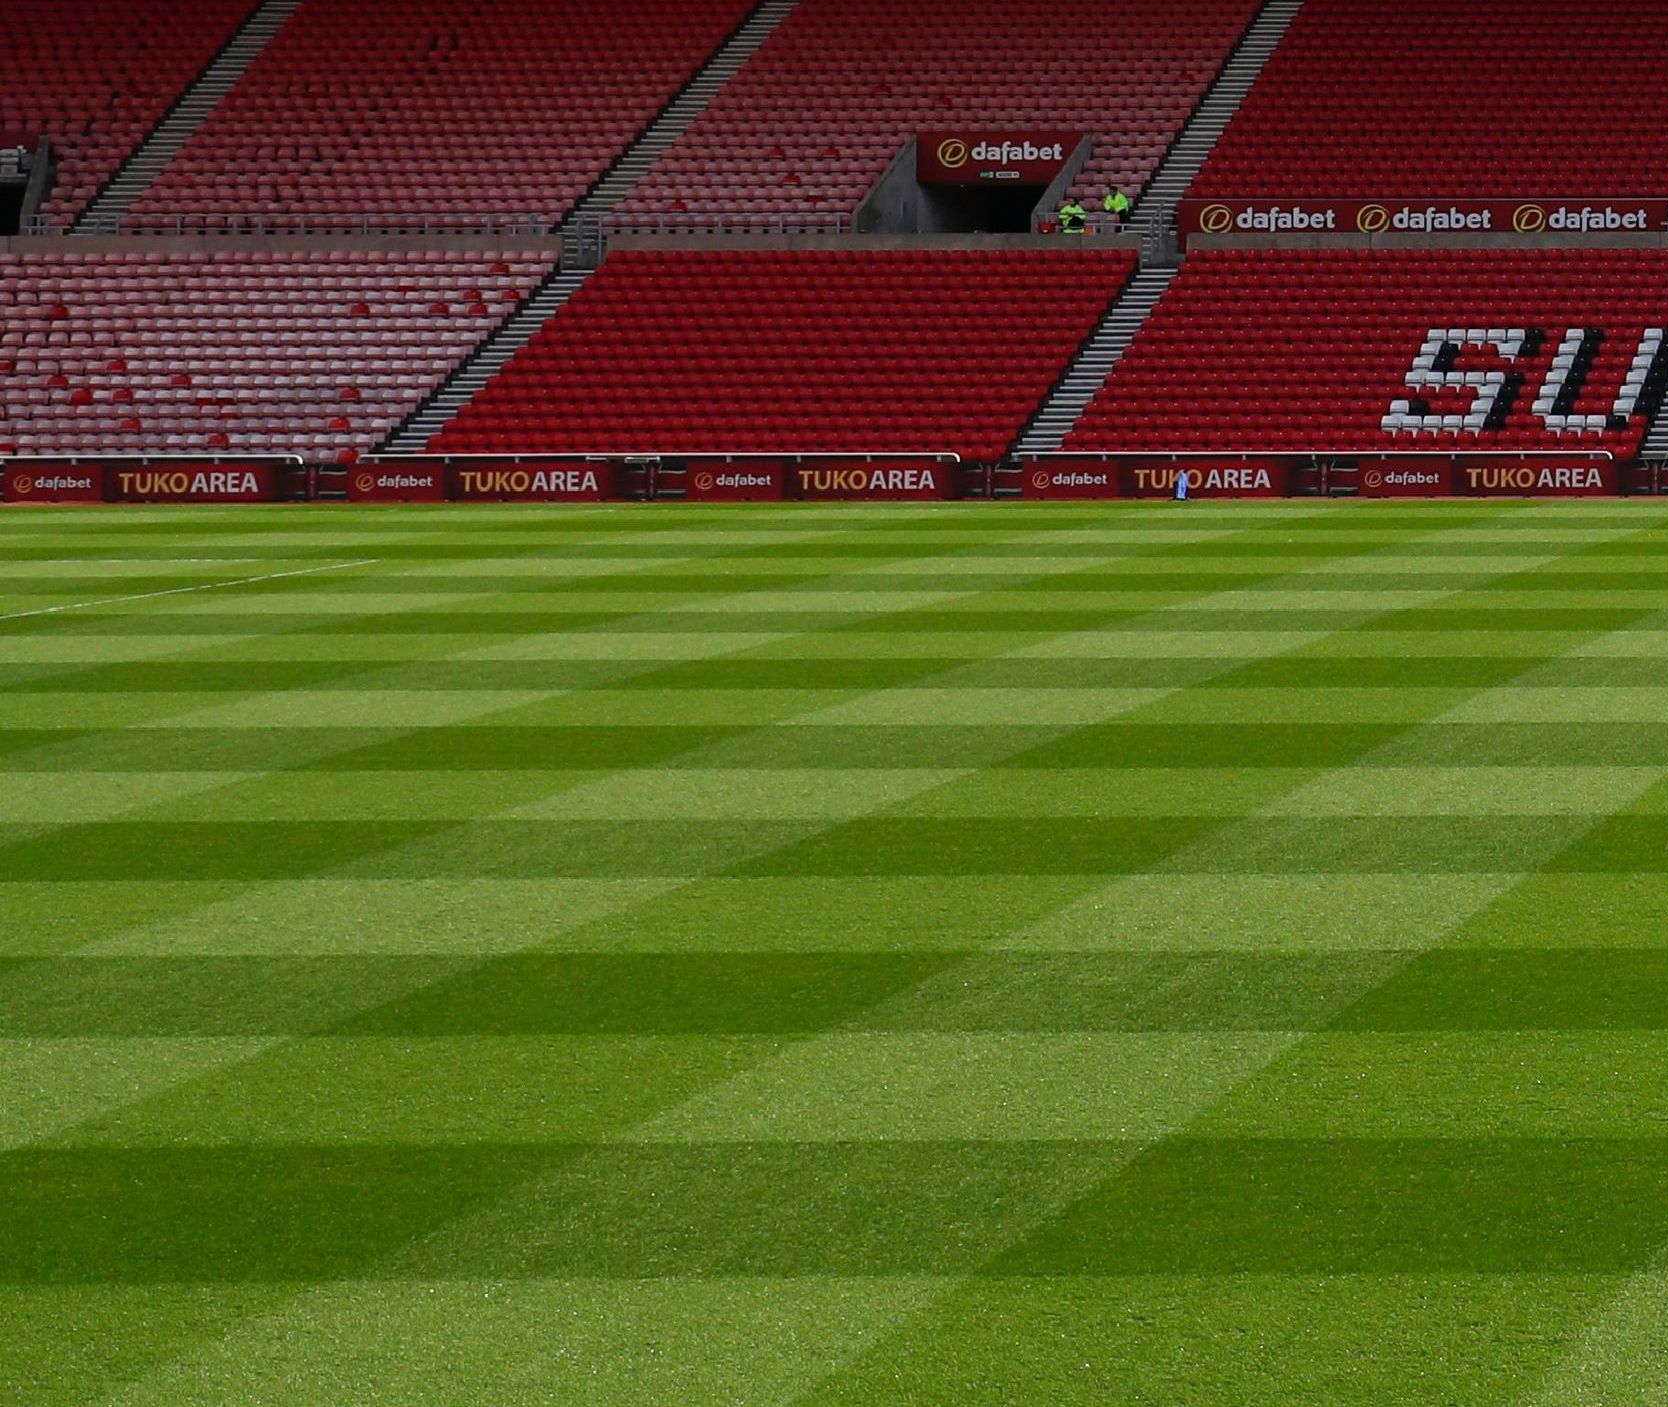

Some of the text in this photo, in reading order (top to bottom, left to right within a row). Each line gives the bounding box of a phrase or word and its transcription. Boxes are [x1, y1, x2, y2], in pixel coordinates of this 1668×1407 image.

[971, 140, 1063, 164] dafabet
[1237, 205, 1335, 232] dafabet
[1393, 205, 1491, 232] dafabet
[1549, 205, 1647, 232] dafabet
[34, 476, 91, 492] dafabet
[377, 474, 433, 490] dafabet
[715, 473, 771, 489] dafabet
[1051, 472, 1108, 488] dafabet
[1384, 471, 1440, 487] dafabet
